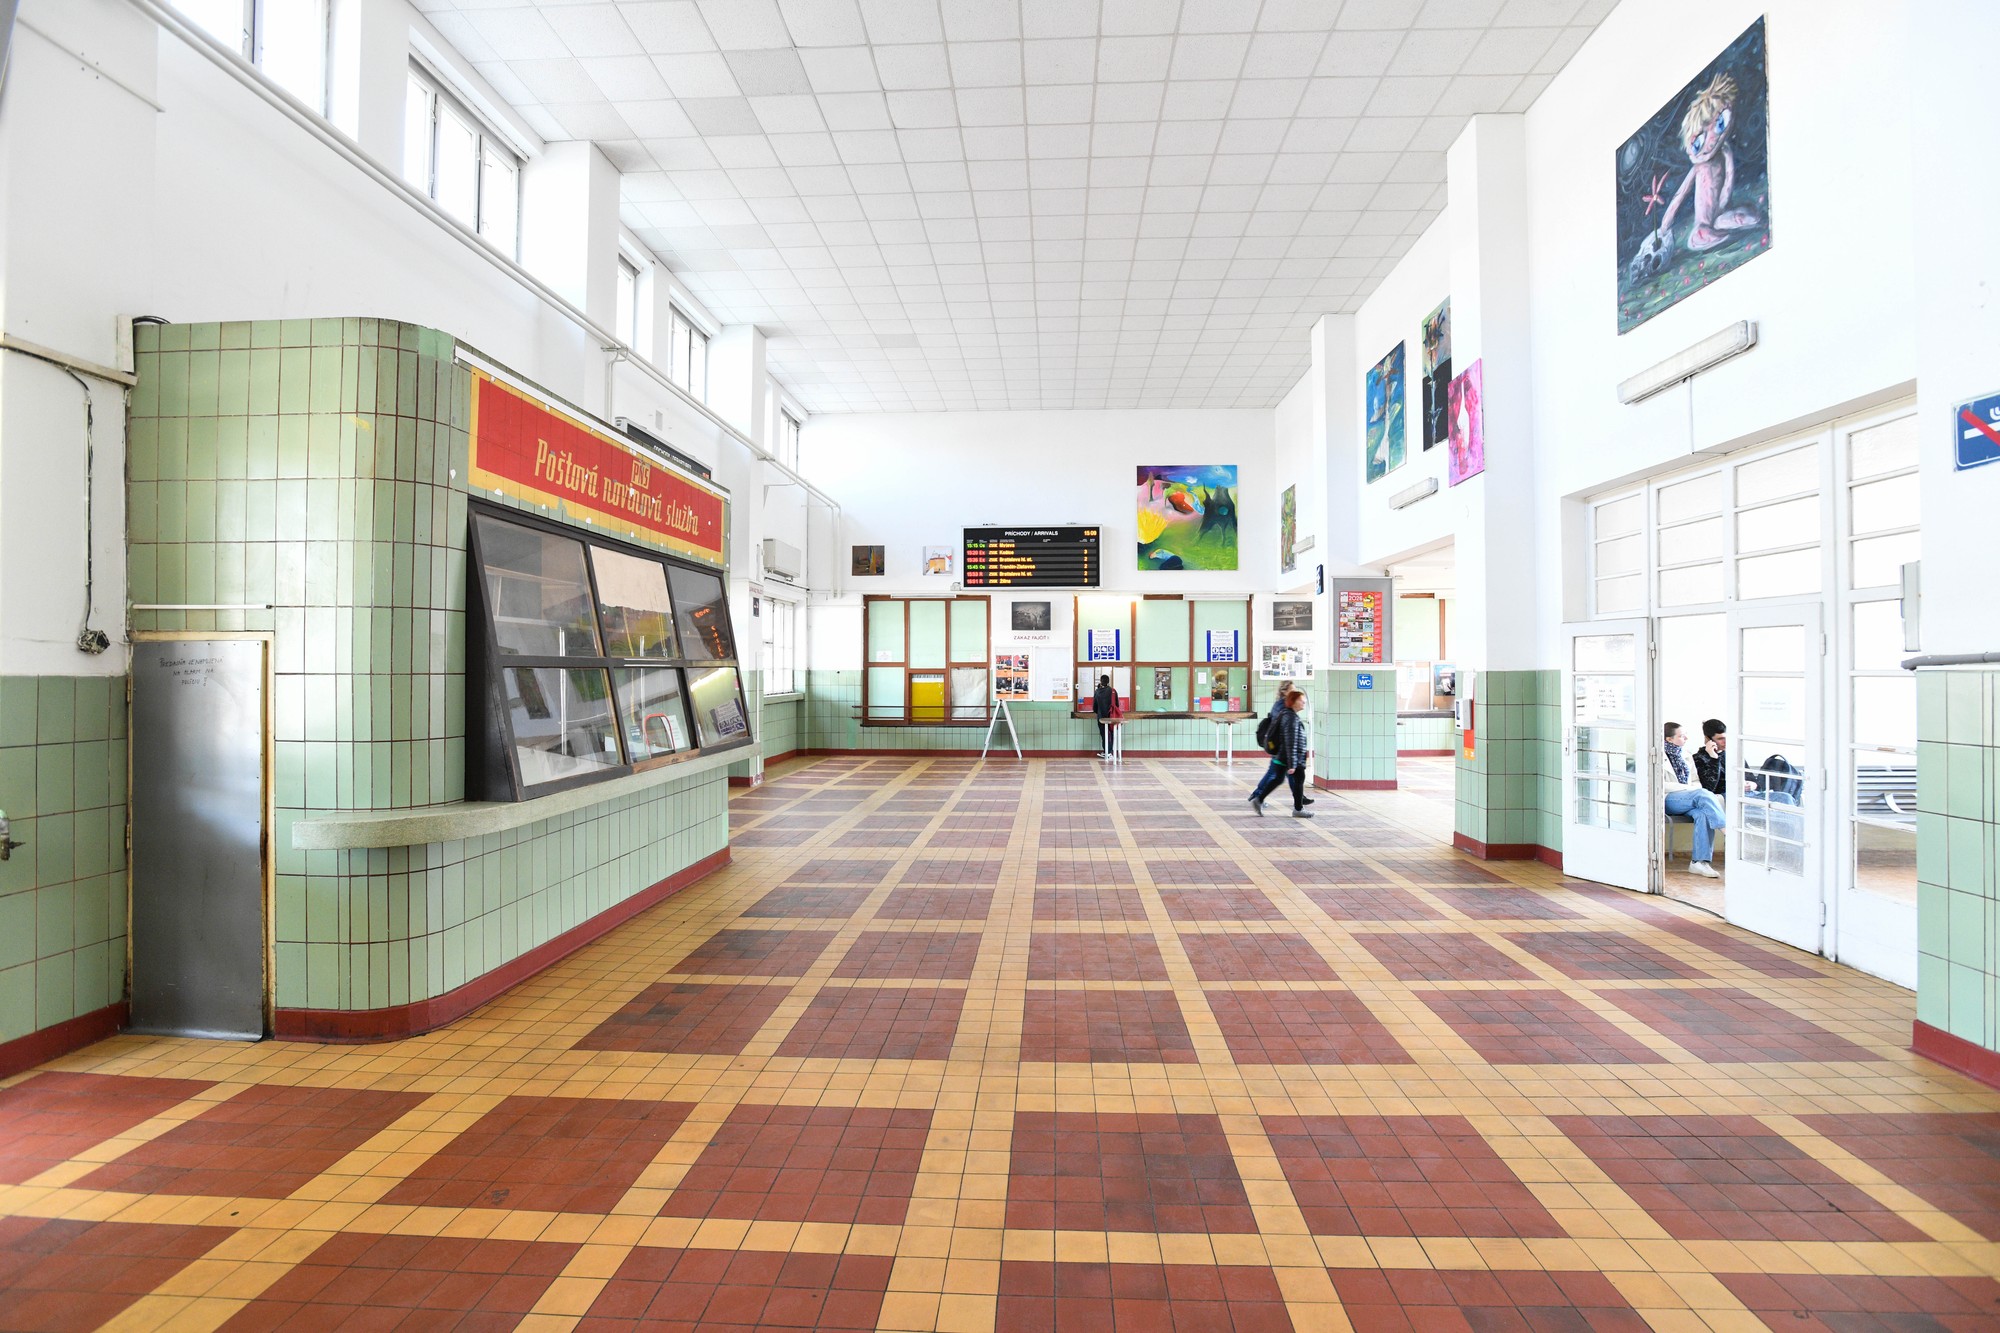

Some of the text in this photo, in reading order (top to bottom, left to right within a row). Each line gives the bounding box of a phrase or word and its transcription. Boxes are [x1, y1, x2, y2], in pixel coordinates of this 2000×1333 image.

[534, 438, 599, 498] Poštová
[602, 476, 662, 524] novinová
[665, 499, 699, 536] služba
[632, 462, 649, 487] PNS
